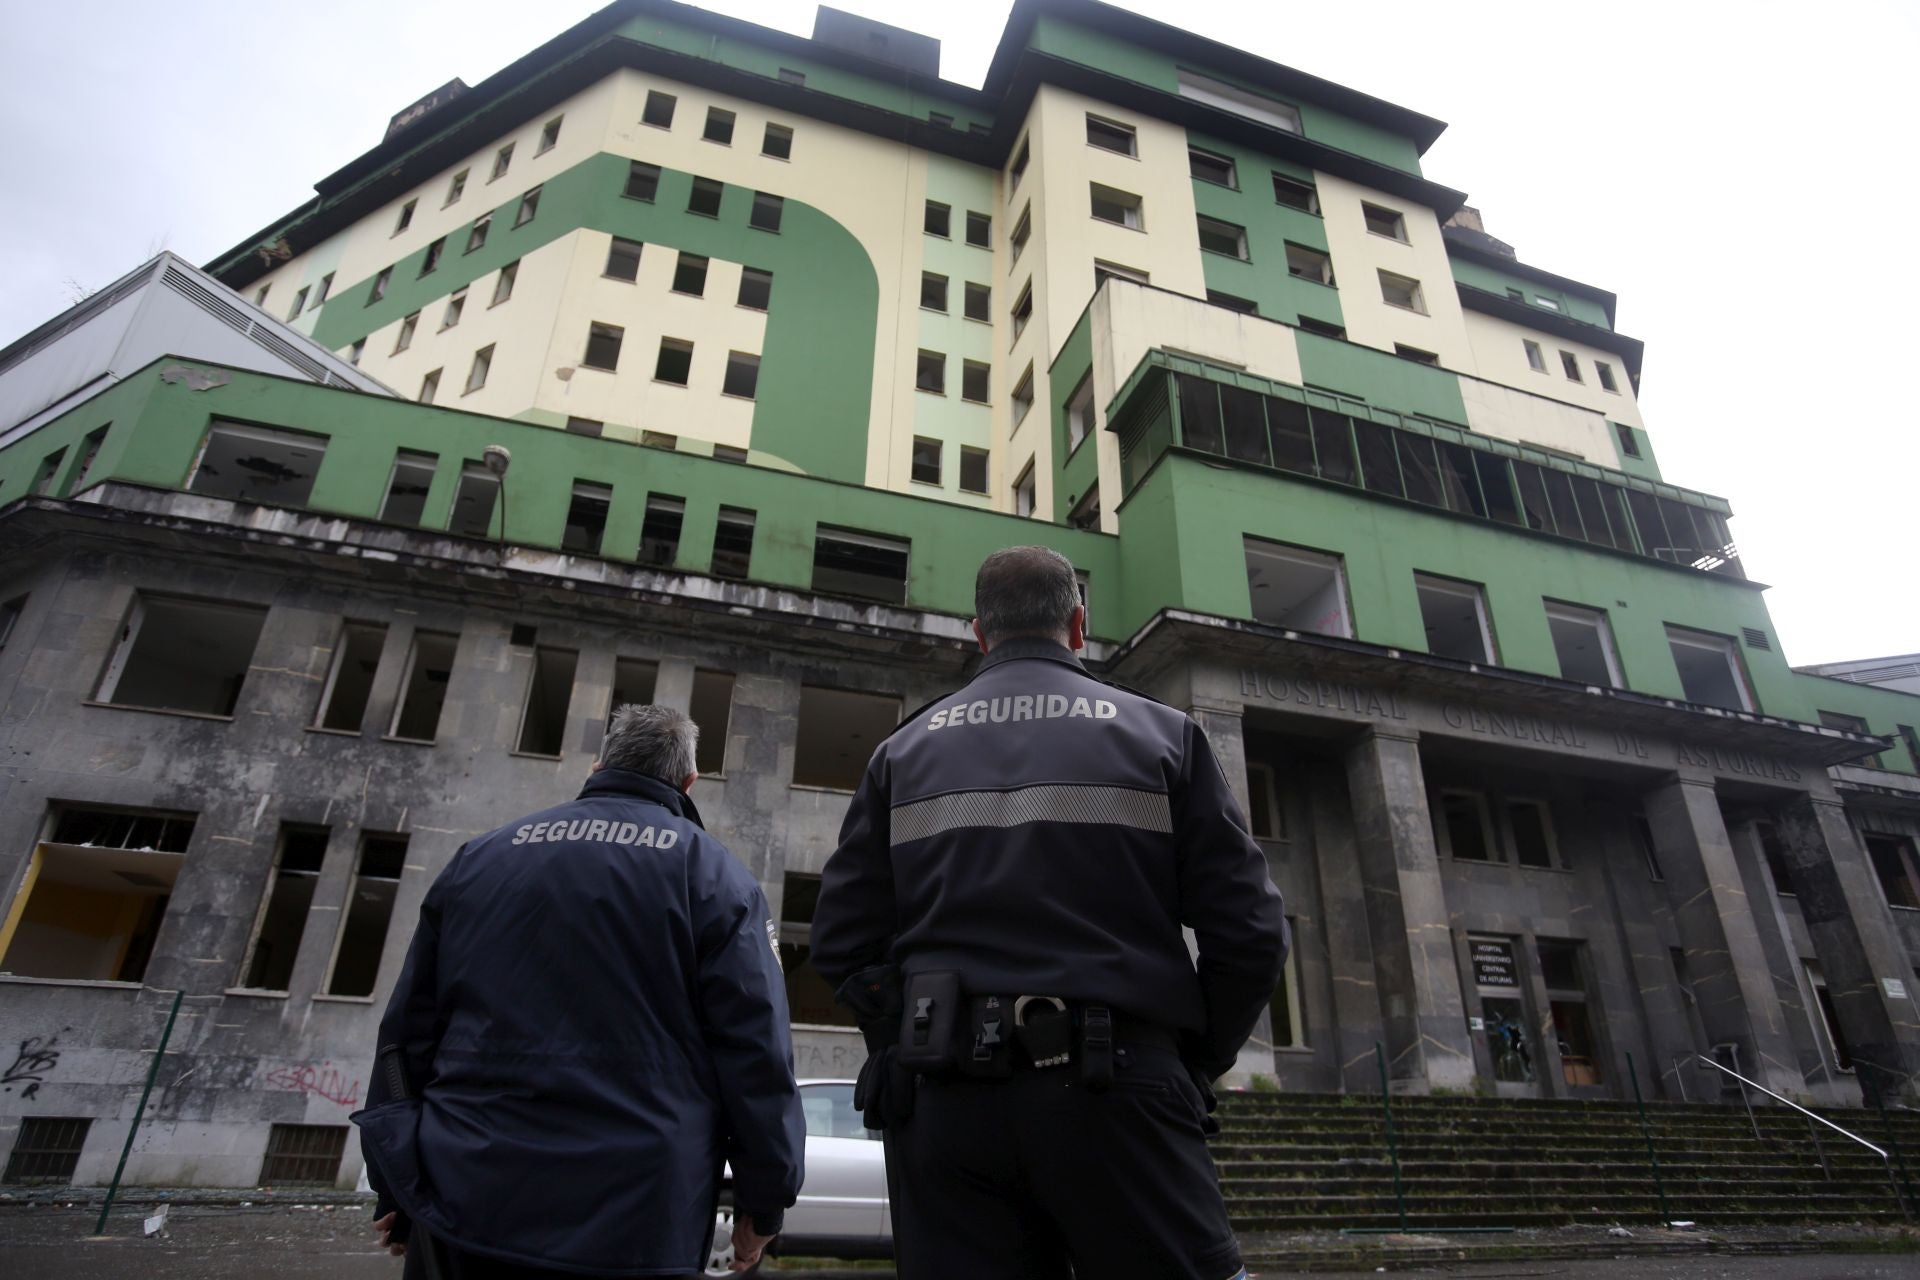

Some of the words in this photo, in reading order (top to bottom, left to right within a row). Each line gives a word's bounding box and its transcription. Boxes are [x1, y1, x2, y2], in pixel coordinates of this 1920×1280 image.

[927, 694, 1117, 731] SEGURIDAD
[1239, 669, 1408, 721] HOSPITAL
[1442, 703, 1587, 749] GENERAL
[1614, 731, 1650, 760] DE
[1675, 740, 1801, 783] ASTURIAS
[511, 819, 678, 849] SEGURIDAD
[1477, 944, 1503, 953] HOSPITAL
[1481, 965, 1507, 974] CENTRAL
